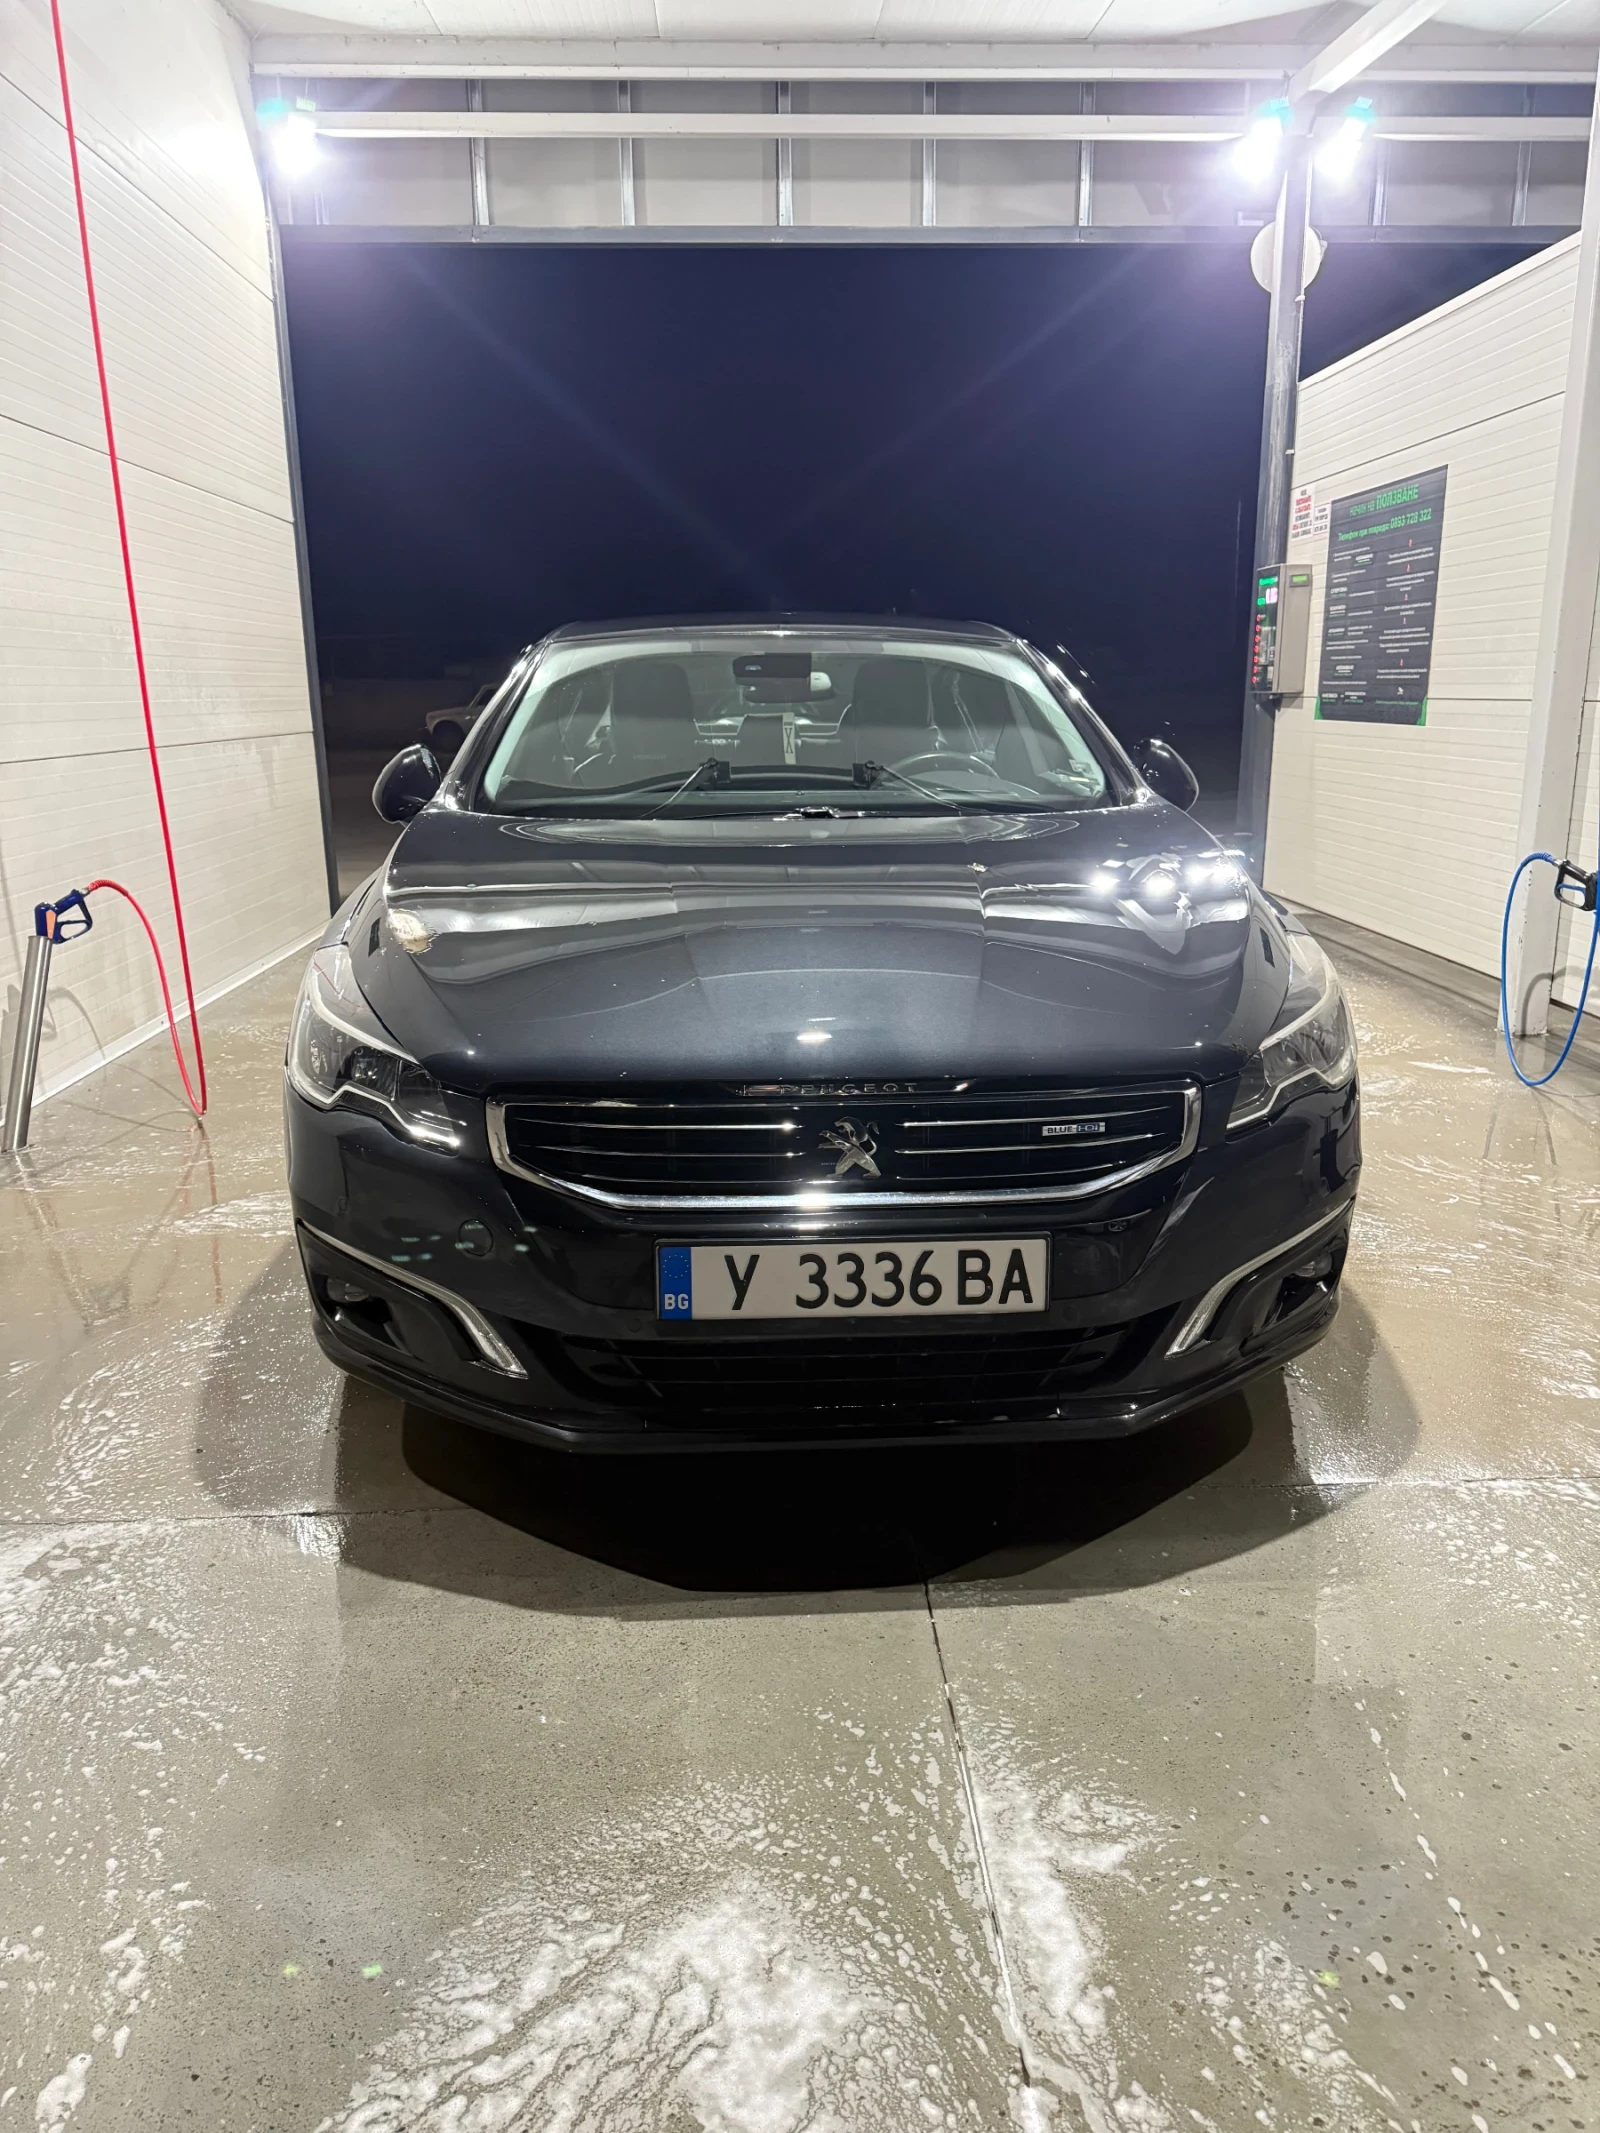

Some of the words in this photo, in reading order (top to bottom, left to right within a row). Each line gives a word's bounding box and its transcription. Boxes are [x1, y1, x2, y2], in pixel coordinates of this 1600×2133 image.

[1376, 485, 1419, 509] ПОЛЗВАНЕ
[1418, 507, 1432, 521] 322
[780, 1082, 917, 1095] PEUGEOT
[1047, 1126, 1073, 1134] BLUE
[795, 1250, 943, 1309] 3336
[664, 1294, 689, 1310] BG
